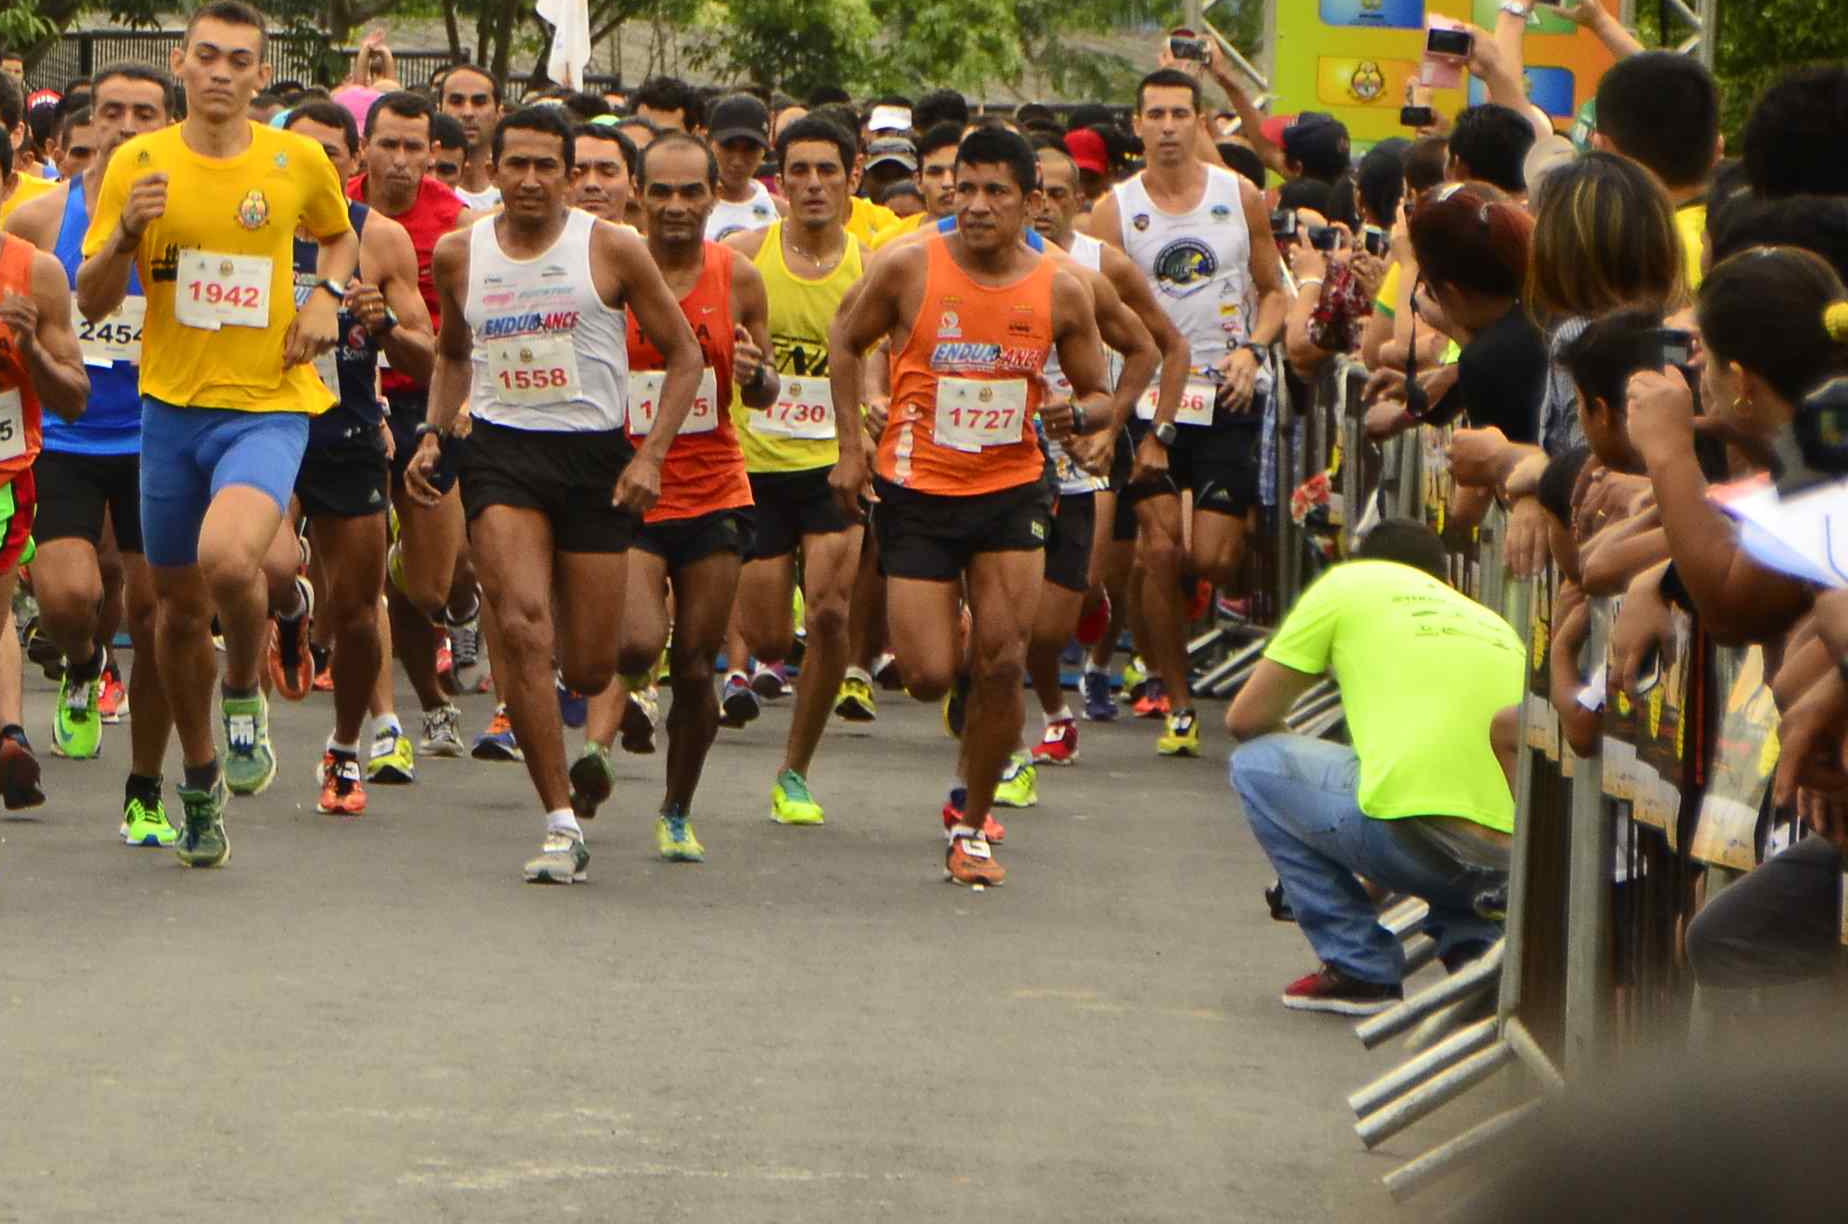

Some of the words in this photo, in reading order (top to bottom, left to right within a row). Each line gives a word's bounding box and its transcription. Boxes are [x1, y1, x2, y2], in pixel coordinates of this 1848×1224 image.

[188, 280, 260, 309] 1942
[498, 368, 568, 391] 1558
[639, 398, 709, 419] 15
[949, 407, 1017, 430] 1727
